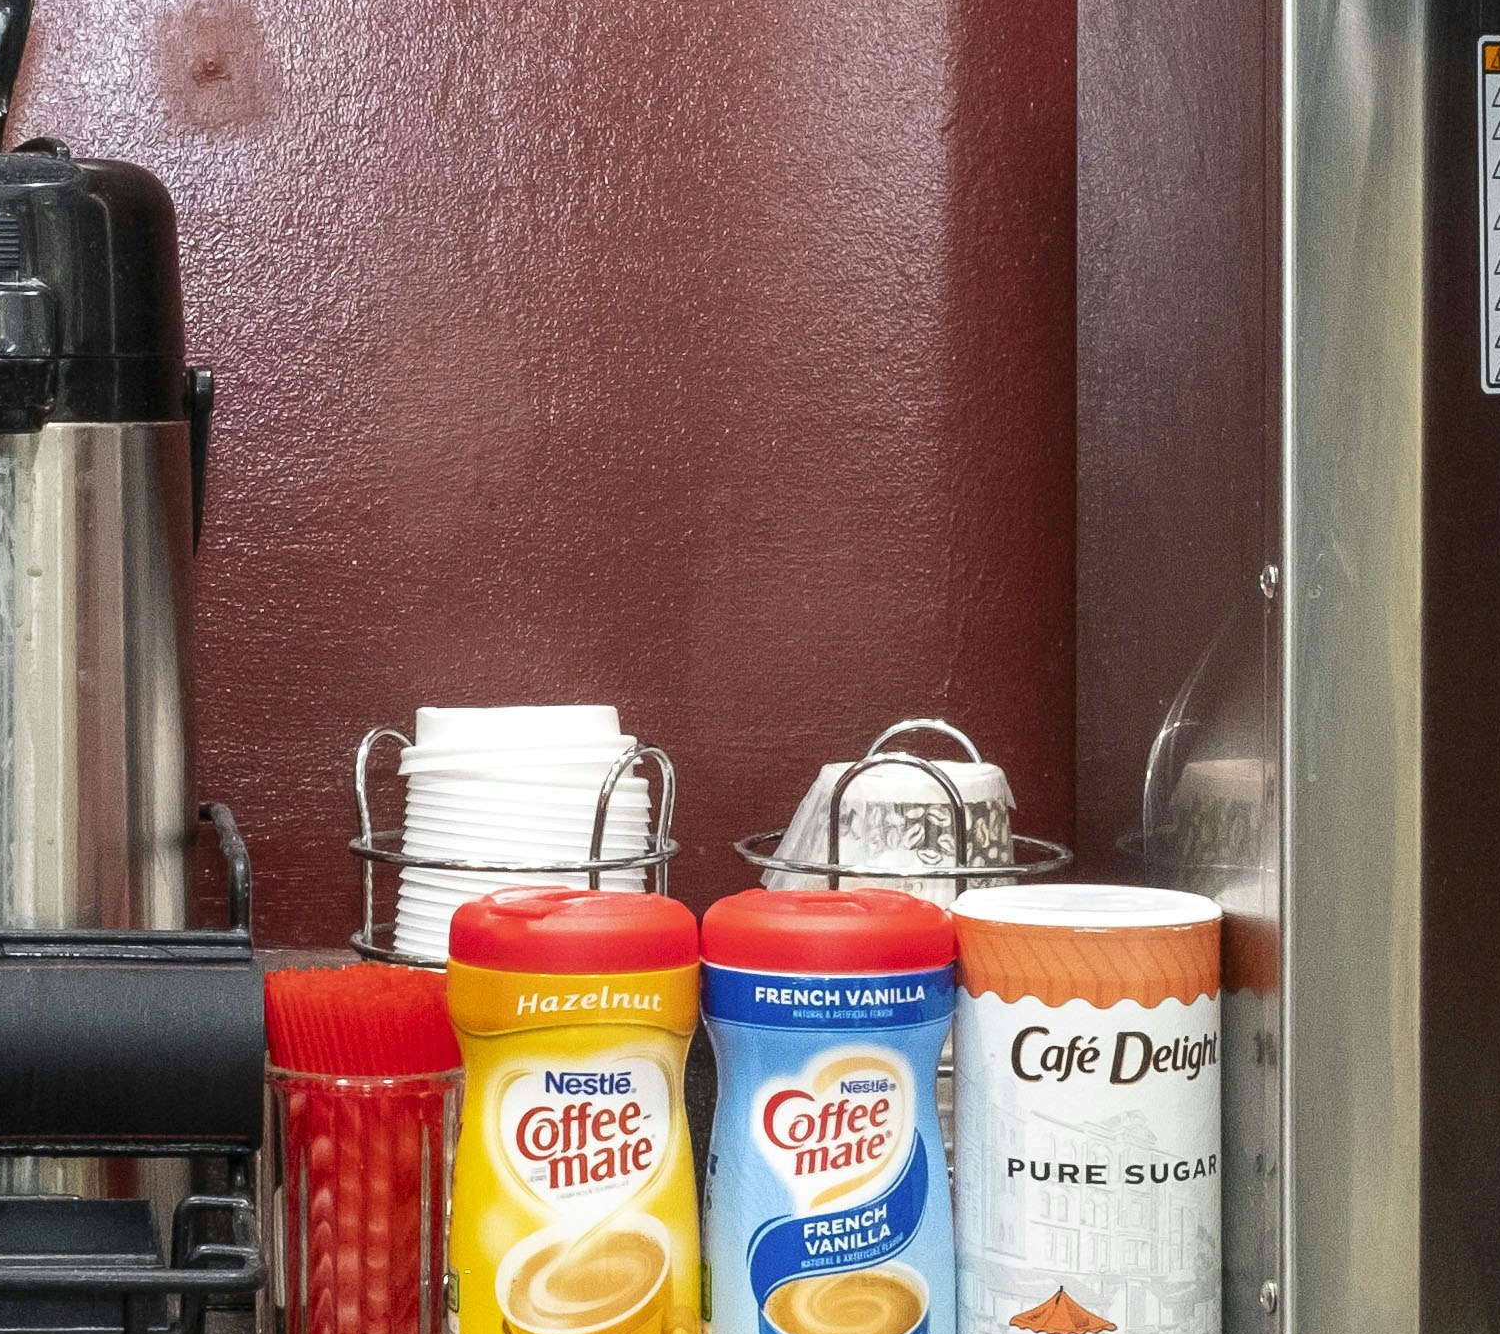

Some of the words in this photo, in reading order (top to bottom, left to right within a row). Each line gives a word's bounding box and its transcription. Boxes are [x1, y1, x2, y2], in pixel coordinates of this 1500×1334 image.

[517, 986, 662, 1016] Hazelnut
[755, 987, 840, 1006] FRENCH
[846, 985, 925, 1006] VANILLA
[1011, 1026, 1101, 1083] Café
[1109, 1031, 1218, 1086] Delight
[545, 1070, 632, 1096] Nestlé
[841, 1079, 888, 1094] Nestlé
[763, 1090, 889, 1150] Coffee
[548, 1137, 653, 1189] mate
[794, 1133, 885, 1176] mate
[1007, 1157, 1107, 1185] PURE
[1125, 1154, 1217, 1185] SUGAR
[804, 1203, 888, 1239] FRENCH
[804, 1224, 891, 1256] VANILLA
